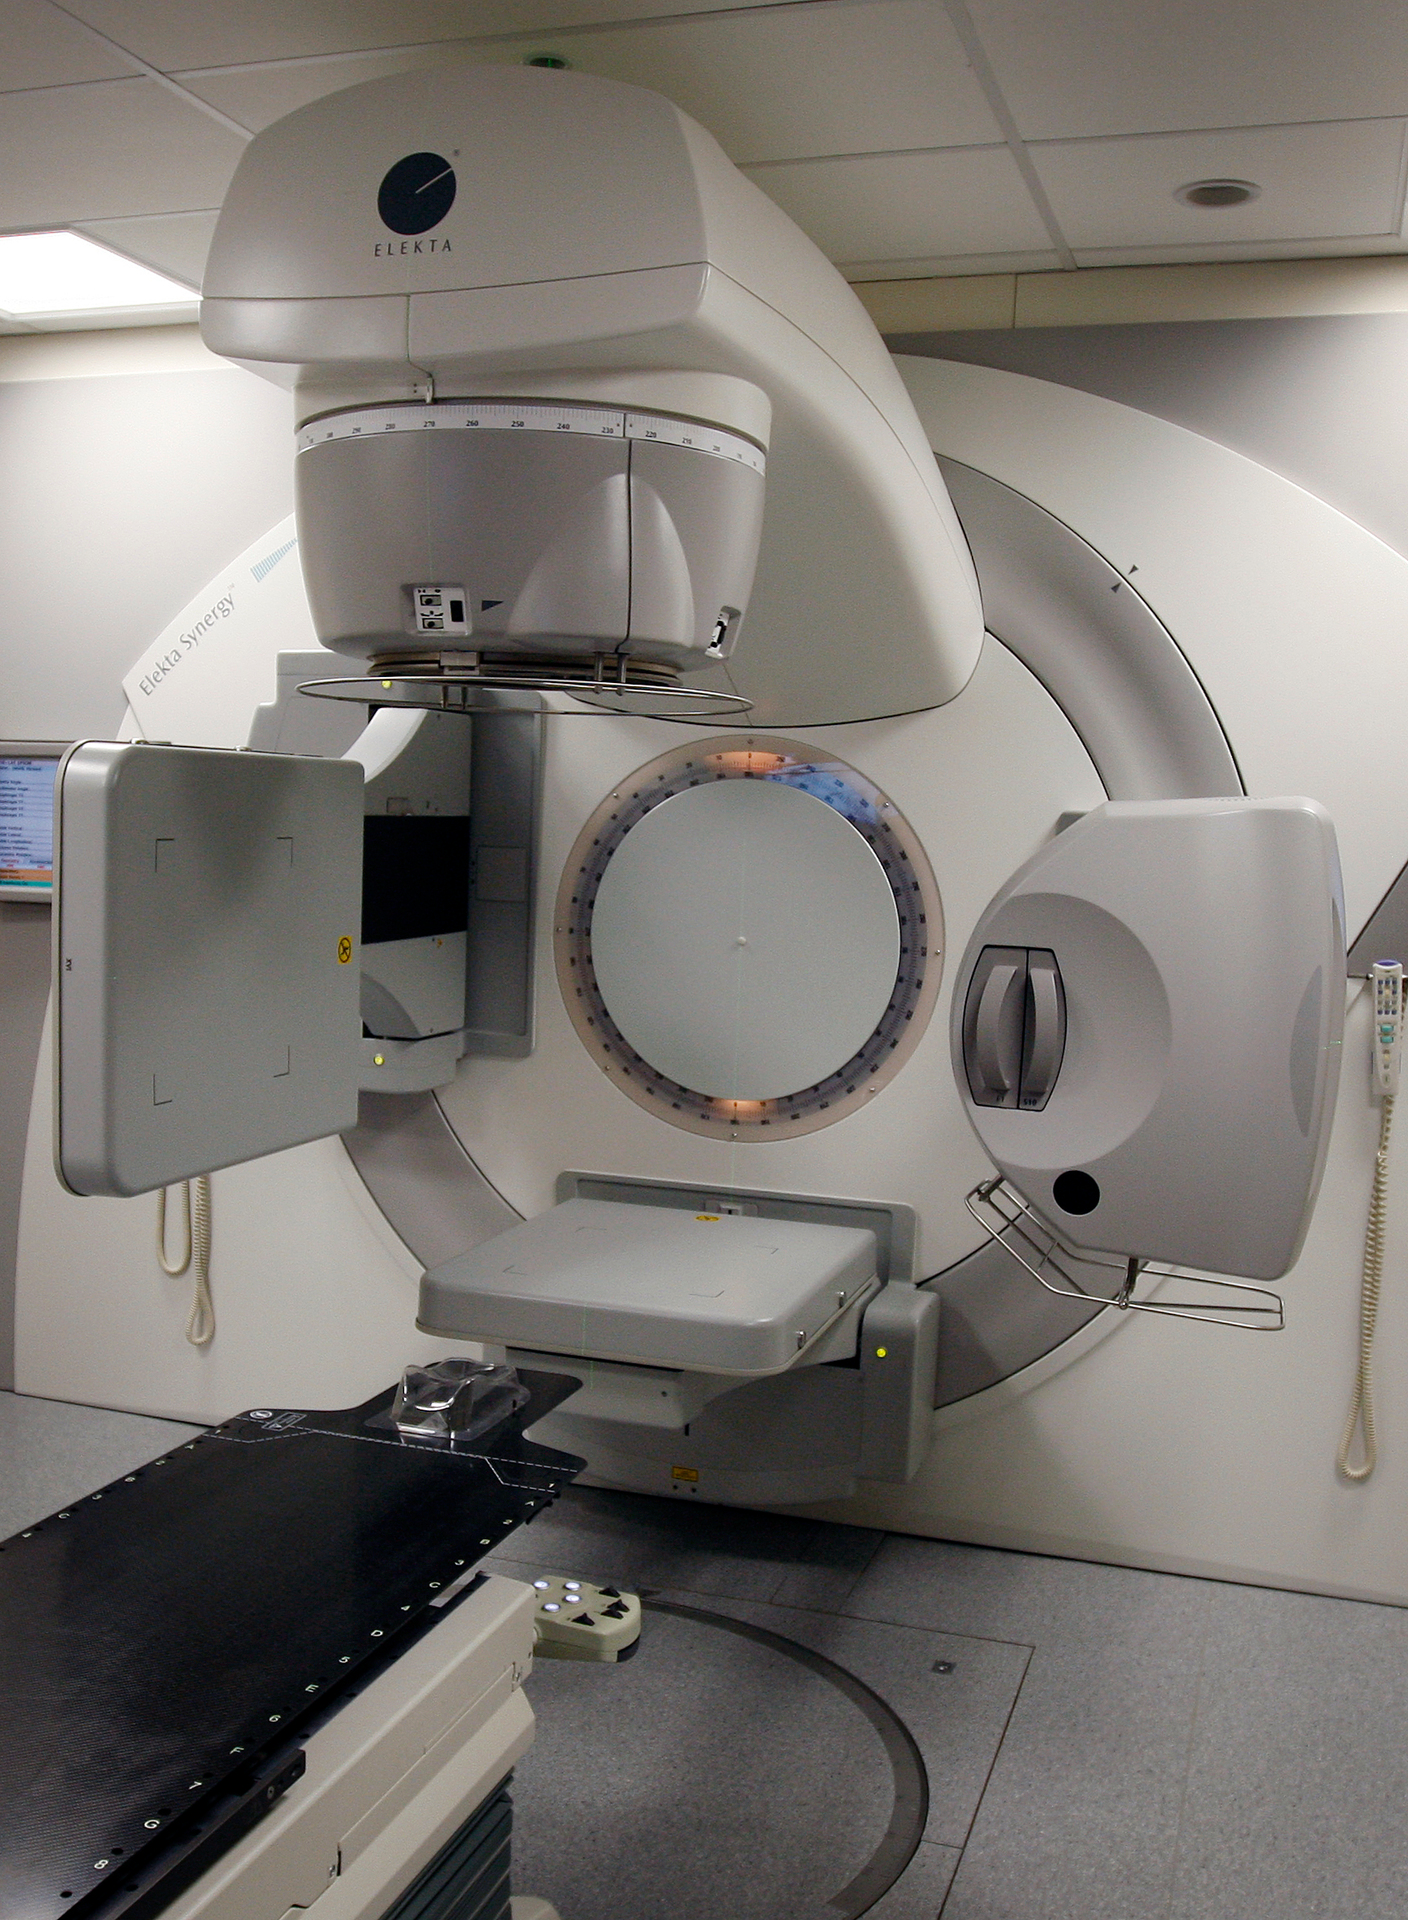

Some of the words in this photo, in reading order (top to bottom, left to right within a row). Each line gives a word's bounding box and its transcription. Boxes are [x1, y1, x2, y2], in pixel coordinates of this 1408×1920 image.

[374, 239, 452, 257] ELEKTA
[423, 420, 436, 428] 270
[465, 419, 479, 427] 260
[510, 420, 525, 428] 250
[556, 422, 571, 430] 240
[601, 426, 614, 434] 230
[645, 430, 657, 438] 220
[138, 648, 182, 697] Elekta
[179, 593, 235, 651] Synergy
[93, 1859, 109, 1870] 8
[143, 1819, 160, 1829] G
[188, 1781, 203, 1790] 7
[229, 1746, 244, 1755] F
[268, 1714, 281, 1723] 6
[304, 1684, 319, 1693] E
[338, 1656, 350, 1664] 5
[370, 1629, 384, 1637] D
[429, 1581, 441, 1589] C
